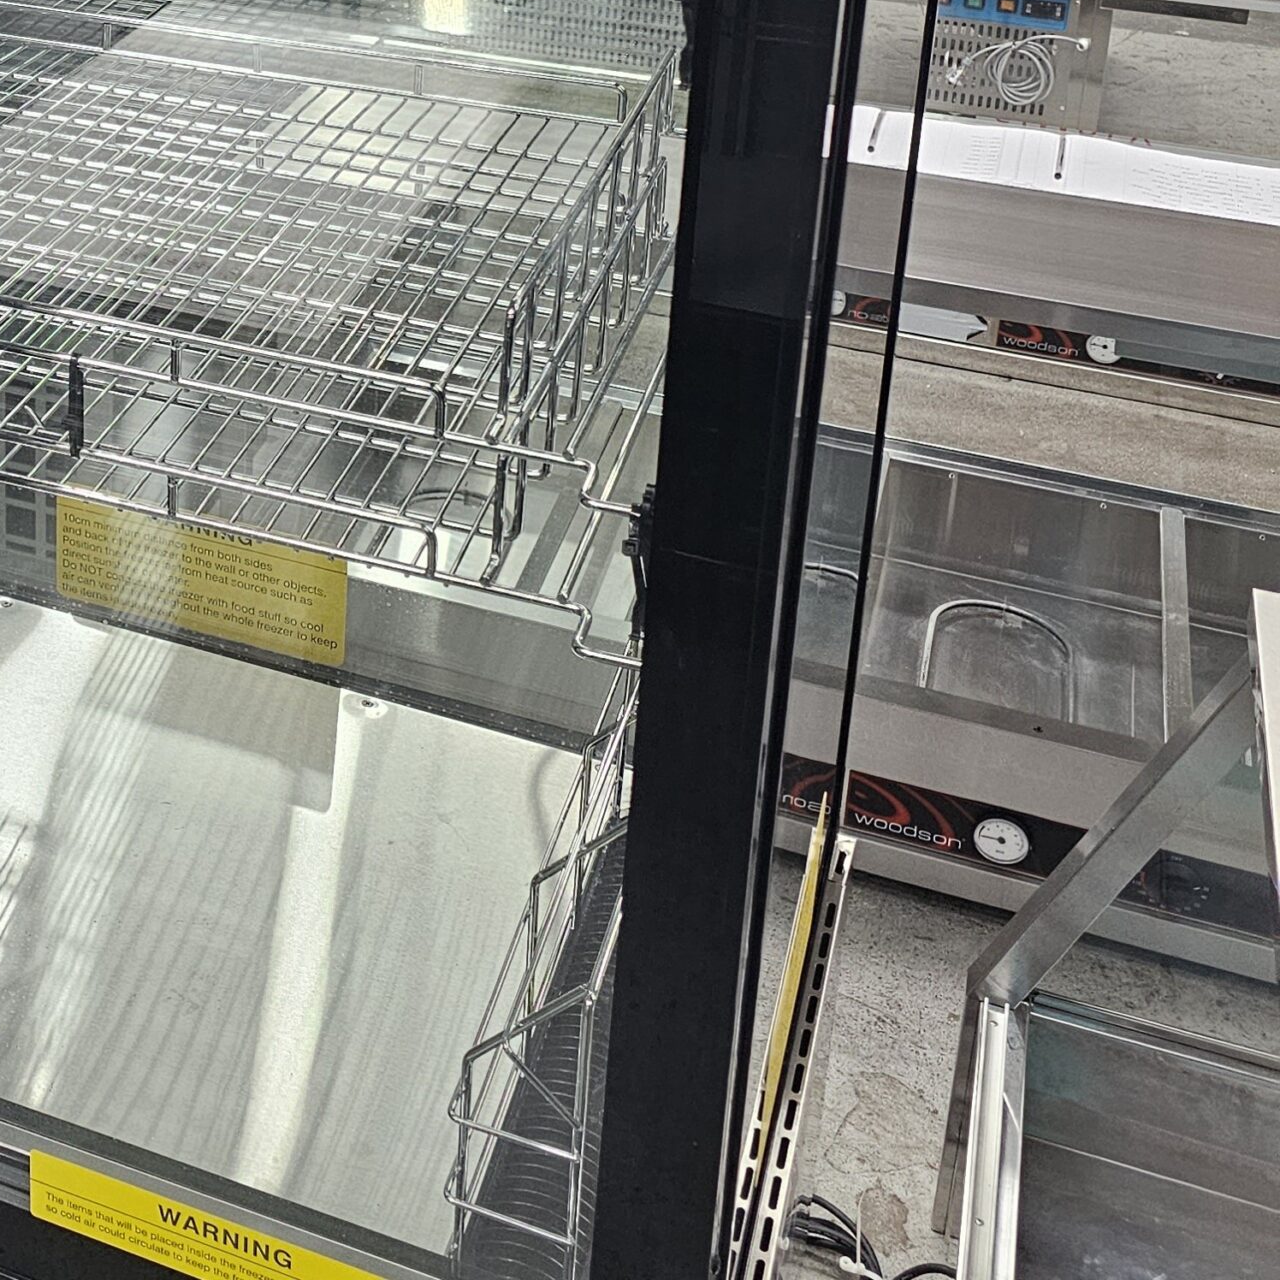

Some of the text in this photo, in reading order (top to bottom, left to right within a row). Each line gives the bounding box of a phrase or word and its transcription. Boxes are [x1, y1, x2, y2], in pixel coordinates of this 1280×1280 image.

[1003, 336, 1074, 356] woodson
[62, 547, 91, 562] direct
[62, 524, 82, 536] and
[84, 529, 108, 542] back
[182, 554, 192, 564] to
[195, 556, 212, 569] the
[215, 561, 236, 574] wall
[238, 569, 250, 577] or
[252, 571, 280, 586] other
[62, 535, 103, 553] Position
[205, 572, 229, 585] heat
[231, 579, 267, 594] source
[270, 589, 297, 602] such
[299, 596, 313, 606] as
[63, 512, 91, 526] 10cm
[190, 542, 214, 556] from
[217, 549, 242, 564] both
[244, 559, 273, 572] sides
[62, 582, 78, 594] the
[80, 587, 108, 602] items
[62, 559, 77, 570] Do
[80, 563, 103, 577] NOT
[206, 595, 228, 608] with
[231, 601, 255, 615] food
[258, 608, 281, 623] stuff
[284, 616, 297, 627] so
[300, 621, 324, 633] cool
[62, 571, 75, 581] air
[77, 575, 96, 586] can
[203, 606, 220, 618] the
[222, 611, 254, 628] whole
[256, 619, 293, 637] freezer
[296, 631, 308, 641] to
[311, 634, 338, 650] keep
[855, 812, 962, 849] woodson
[45, 1204, 58, 1214] so
[60, 1209, 81, 1223] cold
[83, 1218, 96, 1229] air
[98, 1223, 126, 1240] could
[128, 1235, 171, 1257] circulate
[173, 1251, 183, 1261] to
[185, 1256, 211, 1273] keep
[213, 1266, 230, 1279] the
[46, 1191, 276, 1280] The items that will be placed inside the freeze
[158, 1204, 293, 1270] WARNING
